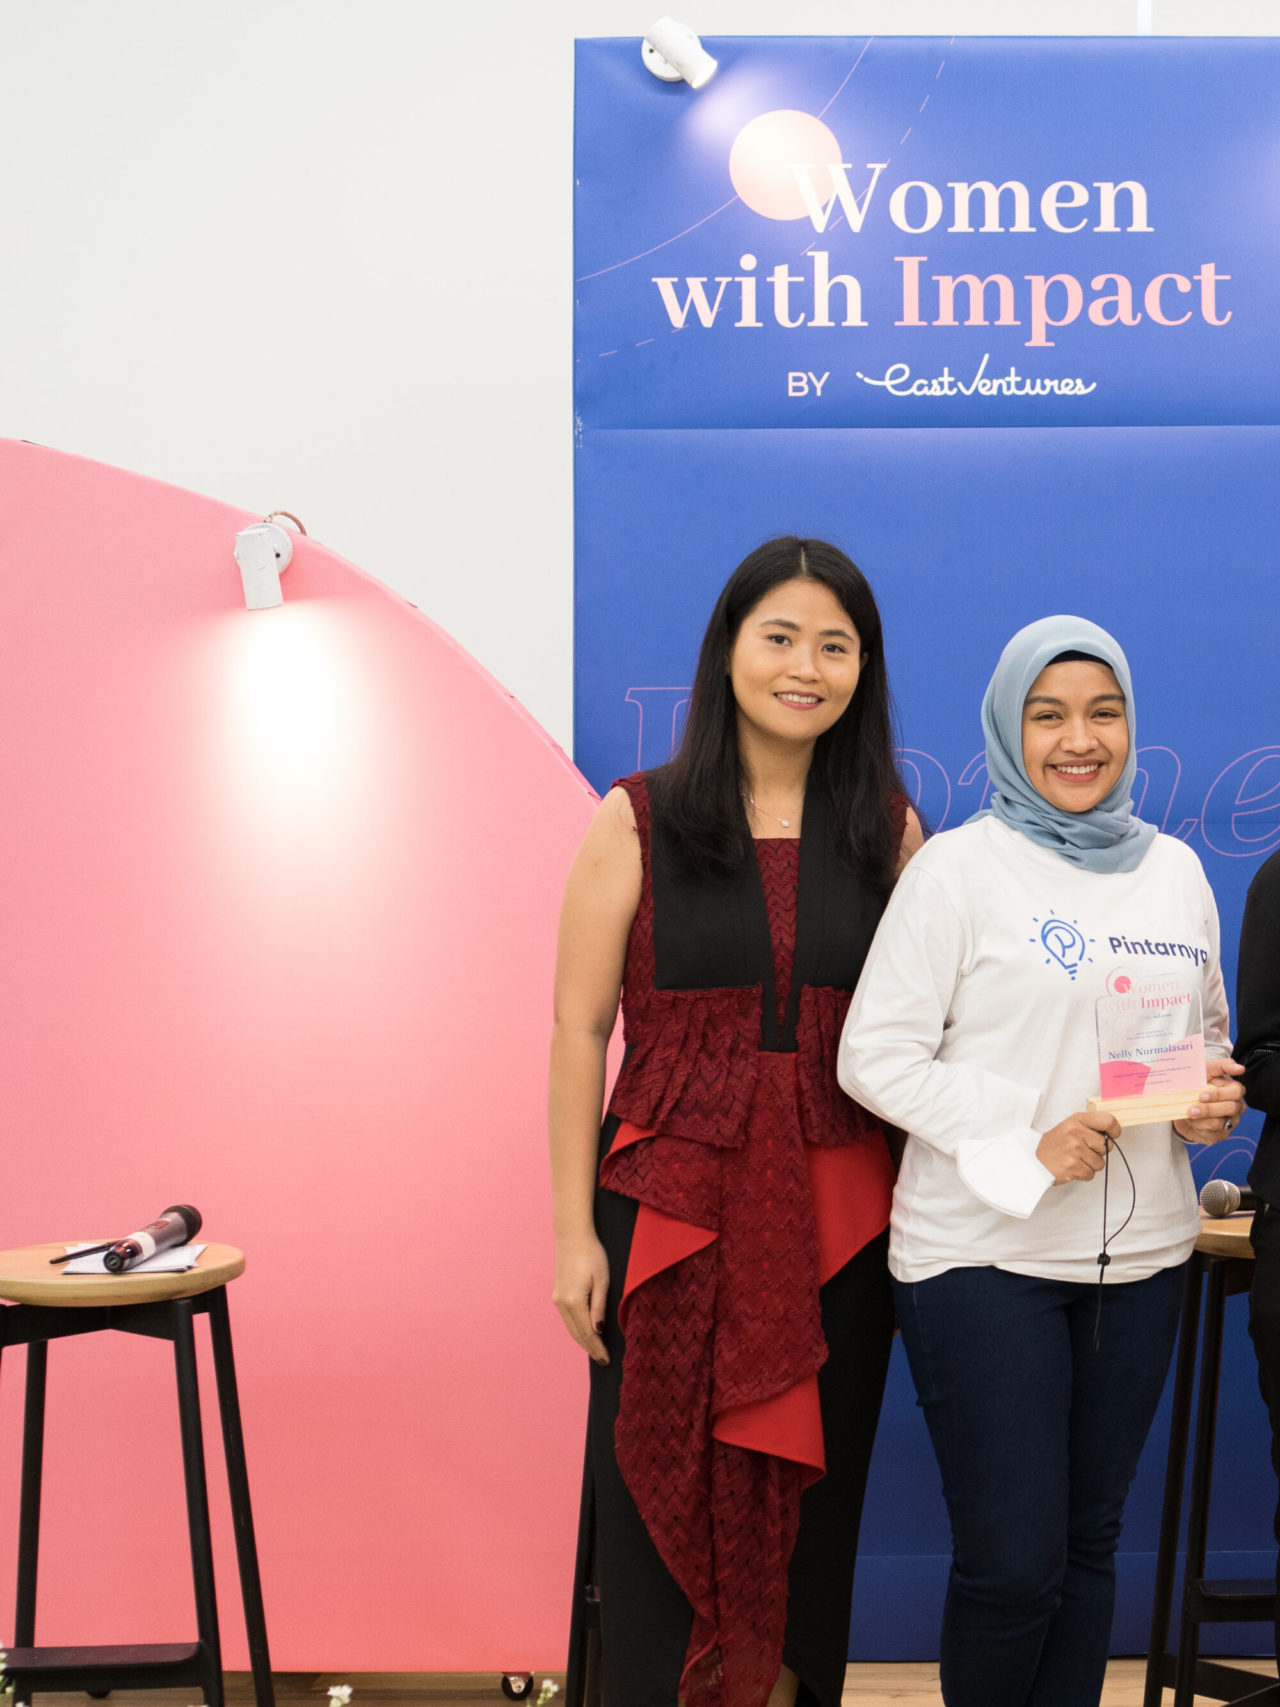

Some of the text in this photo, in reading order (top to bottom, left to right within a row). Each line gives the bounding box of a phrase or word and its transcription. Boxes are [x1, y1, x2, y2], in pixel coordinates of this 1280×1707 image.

[787, 162, 1154, 233] Women
[652, 251, 1233, 347] with Impact
[787, 371, 830, 397] BY
[1140, 993, 1192, 1010] Impact
[1108, 1041, 1193, 1060] Nelly Nurmalasari
